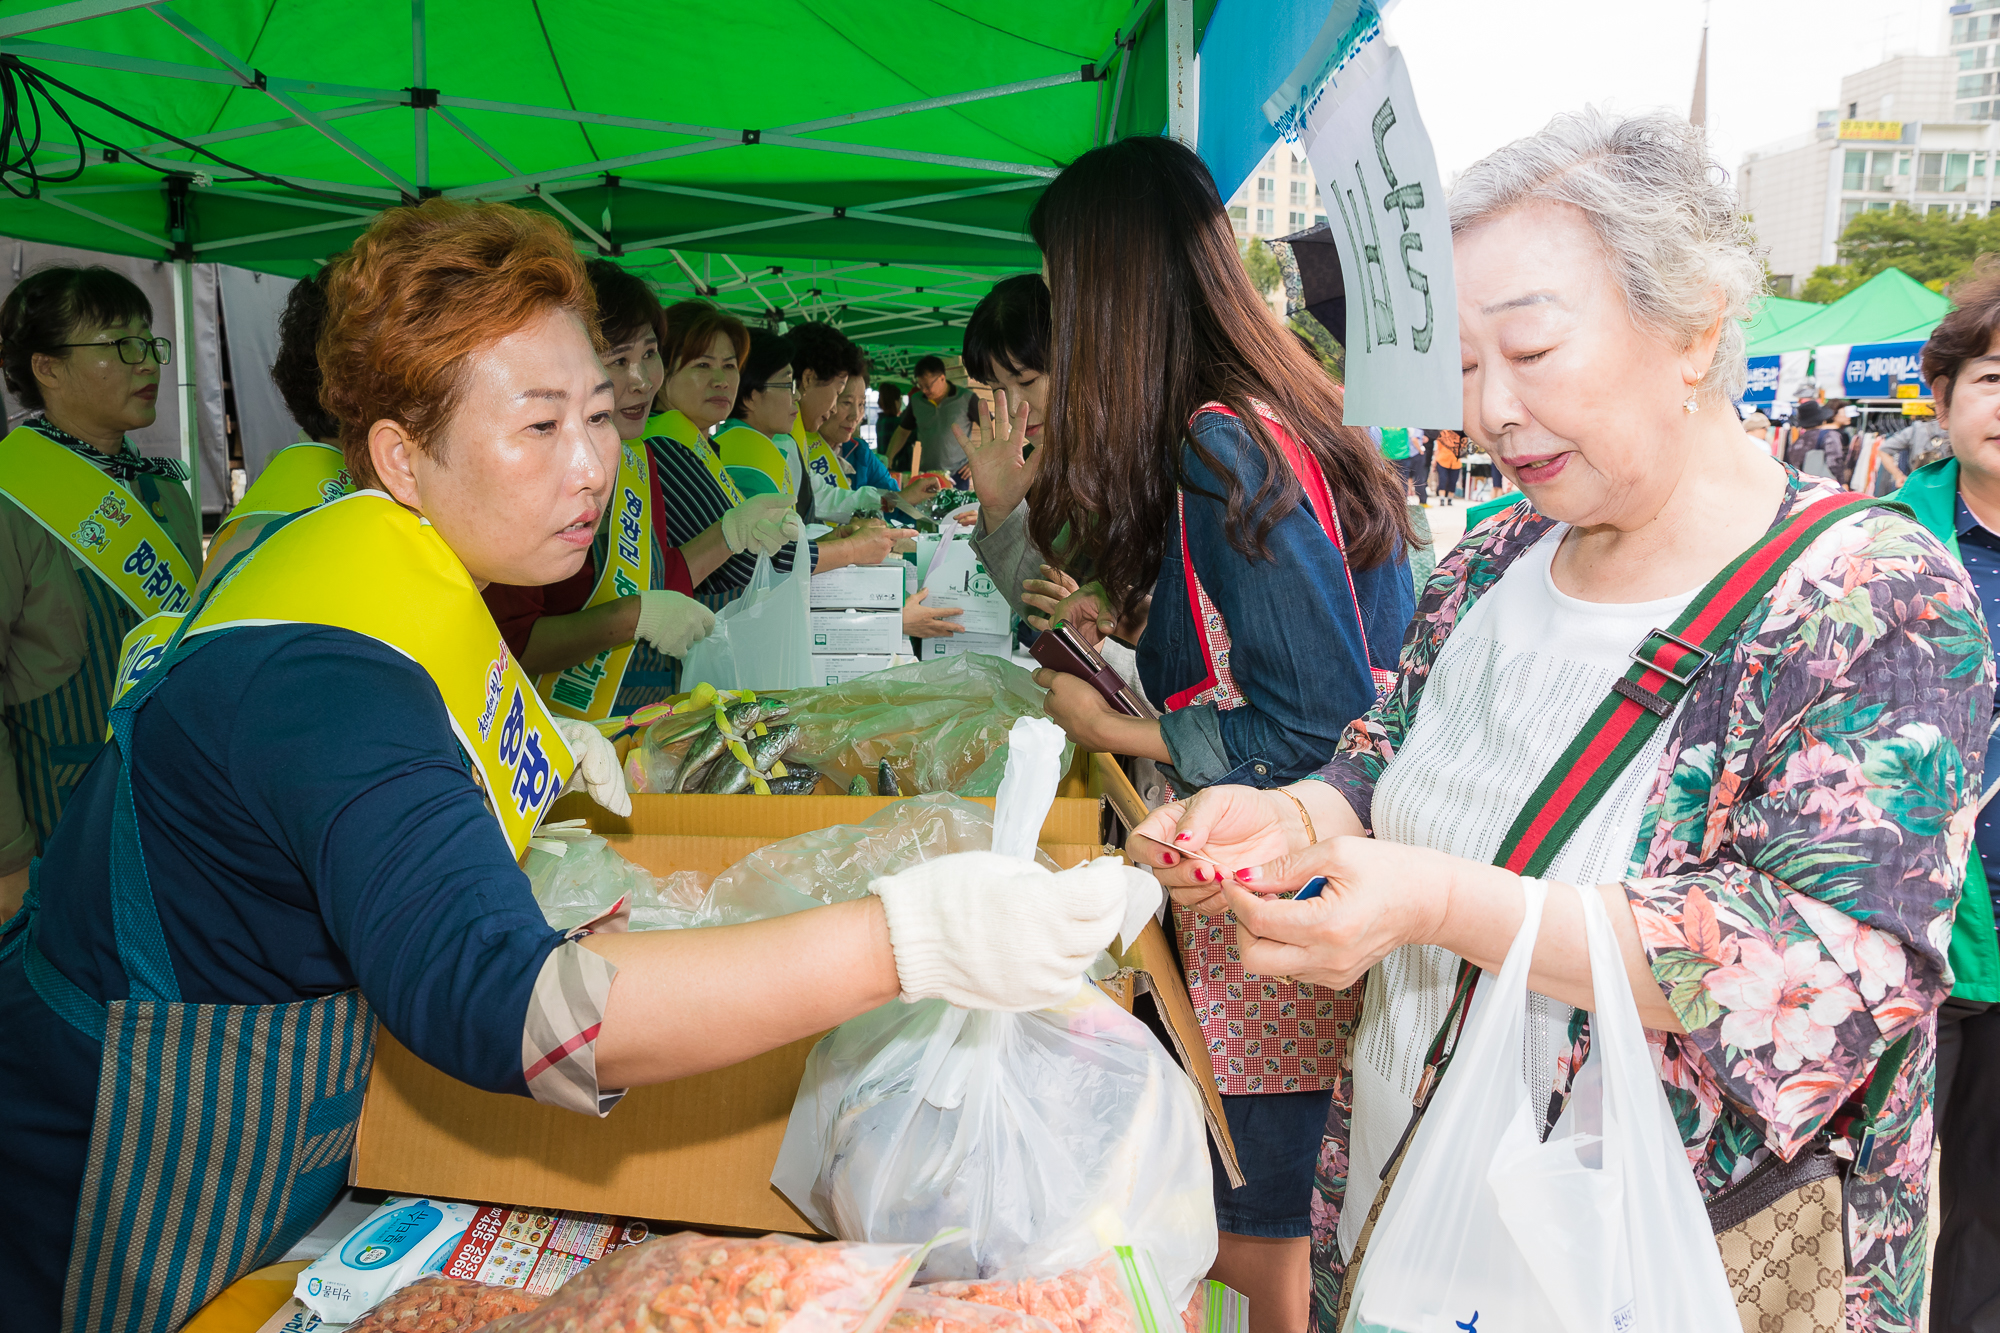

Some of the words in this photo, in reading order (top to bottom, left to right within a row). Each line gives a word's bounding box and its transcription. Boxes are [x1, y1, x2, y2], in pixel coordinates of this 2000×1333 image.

[619, 487, 643, 569] 영광군
[382, 1210, 429, 1246] 물티슈
[449, 1214, 489, 1278] 455-6068
[322, 1284, 352, 1302] 물티슈
